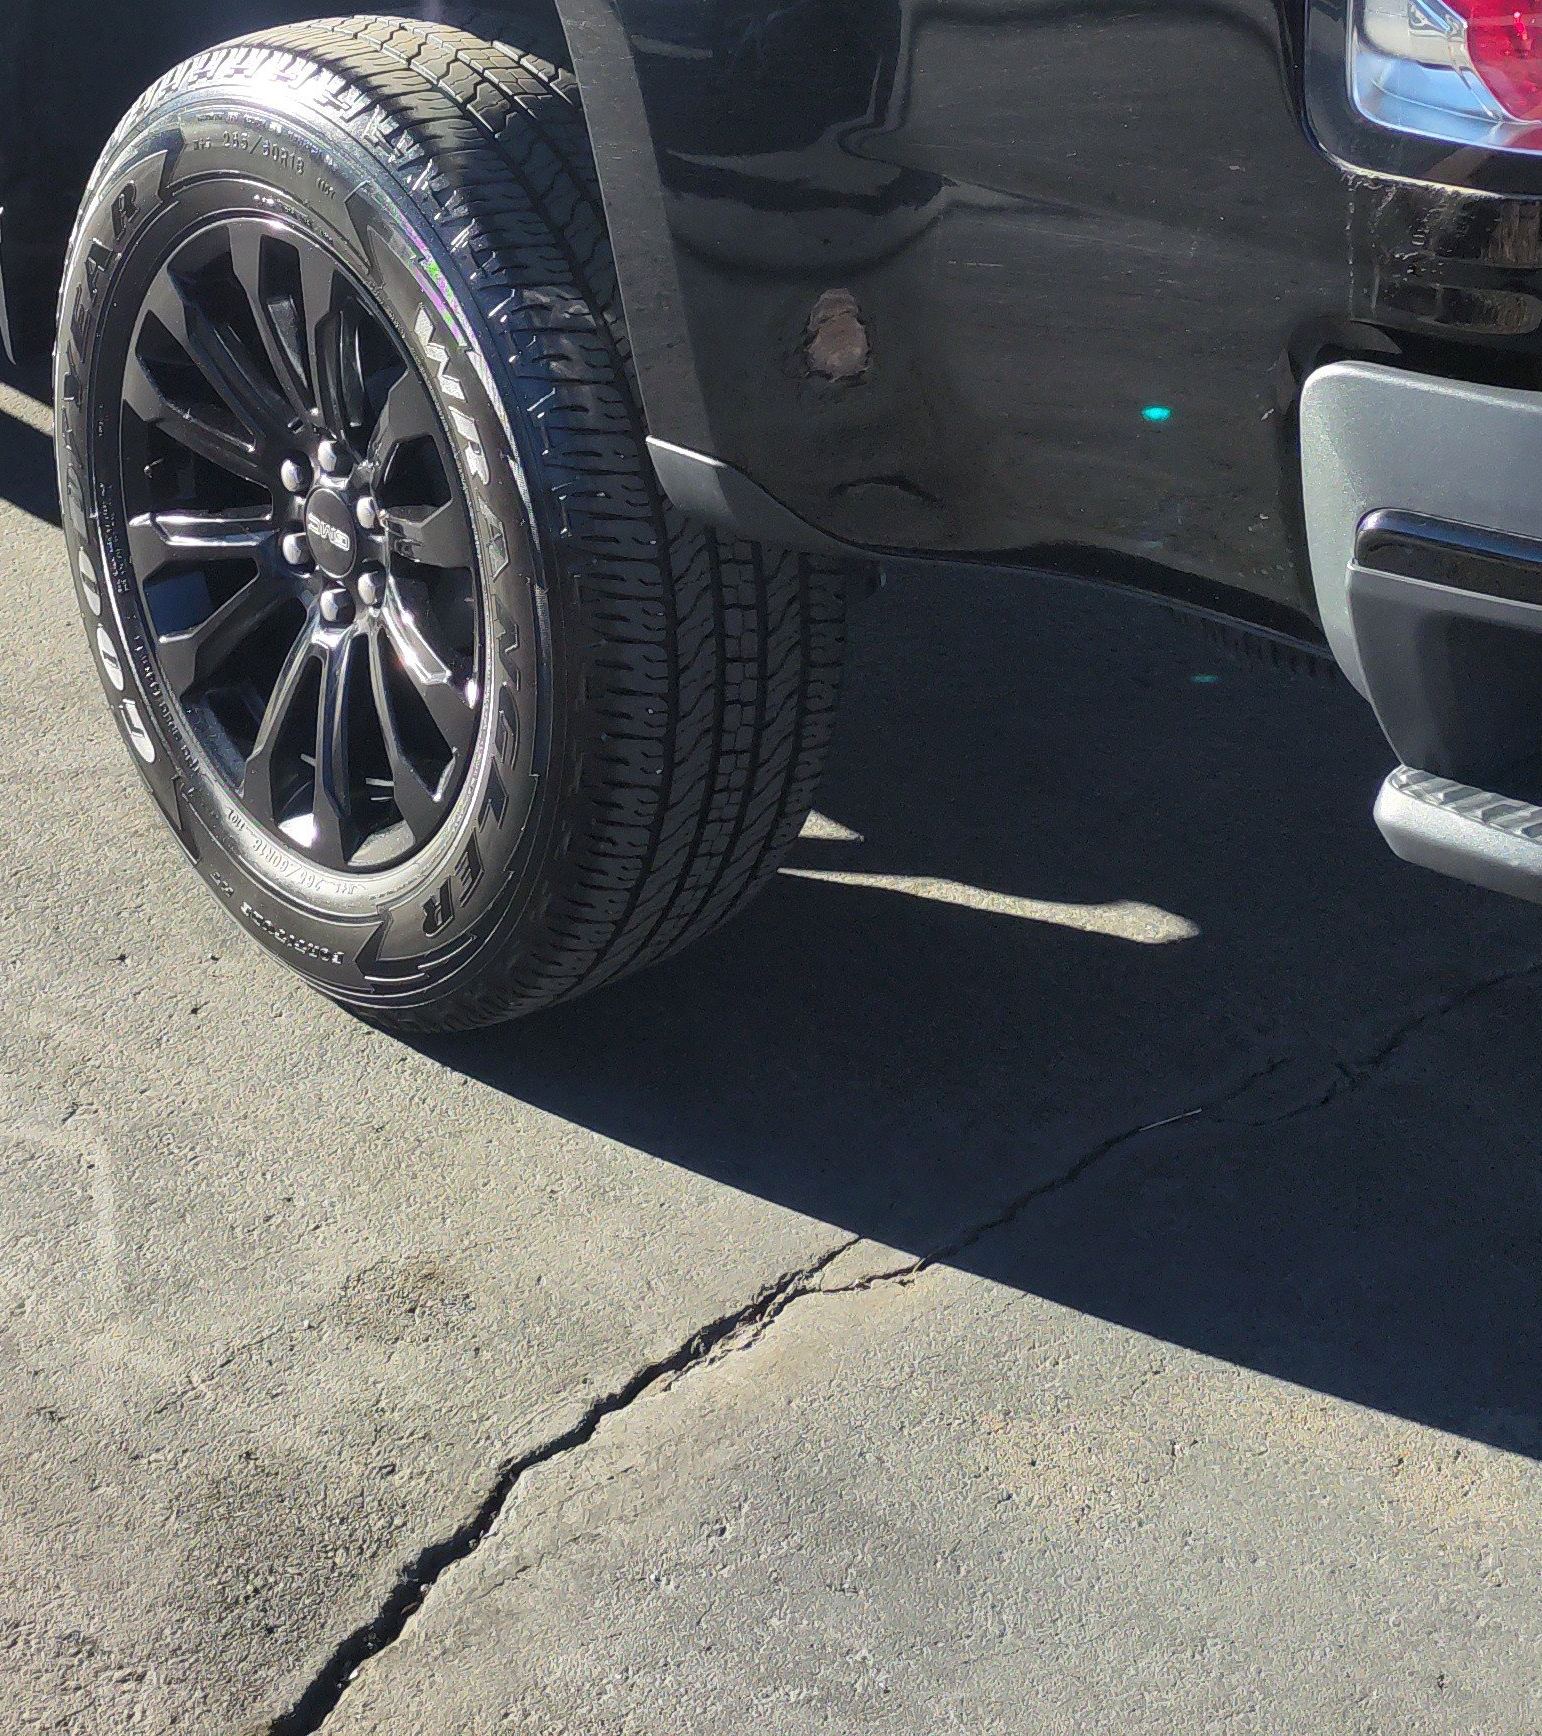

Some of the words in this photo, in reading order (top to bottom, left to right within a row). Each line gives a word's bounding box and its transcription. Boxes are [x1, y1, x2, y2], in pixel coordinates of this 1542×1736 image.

[62, 180, 156, 764] GOODYEAR
[308, 511, 350, 552] GMC
[413, 304, 520, 939] WRANGLER
